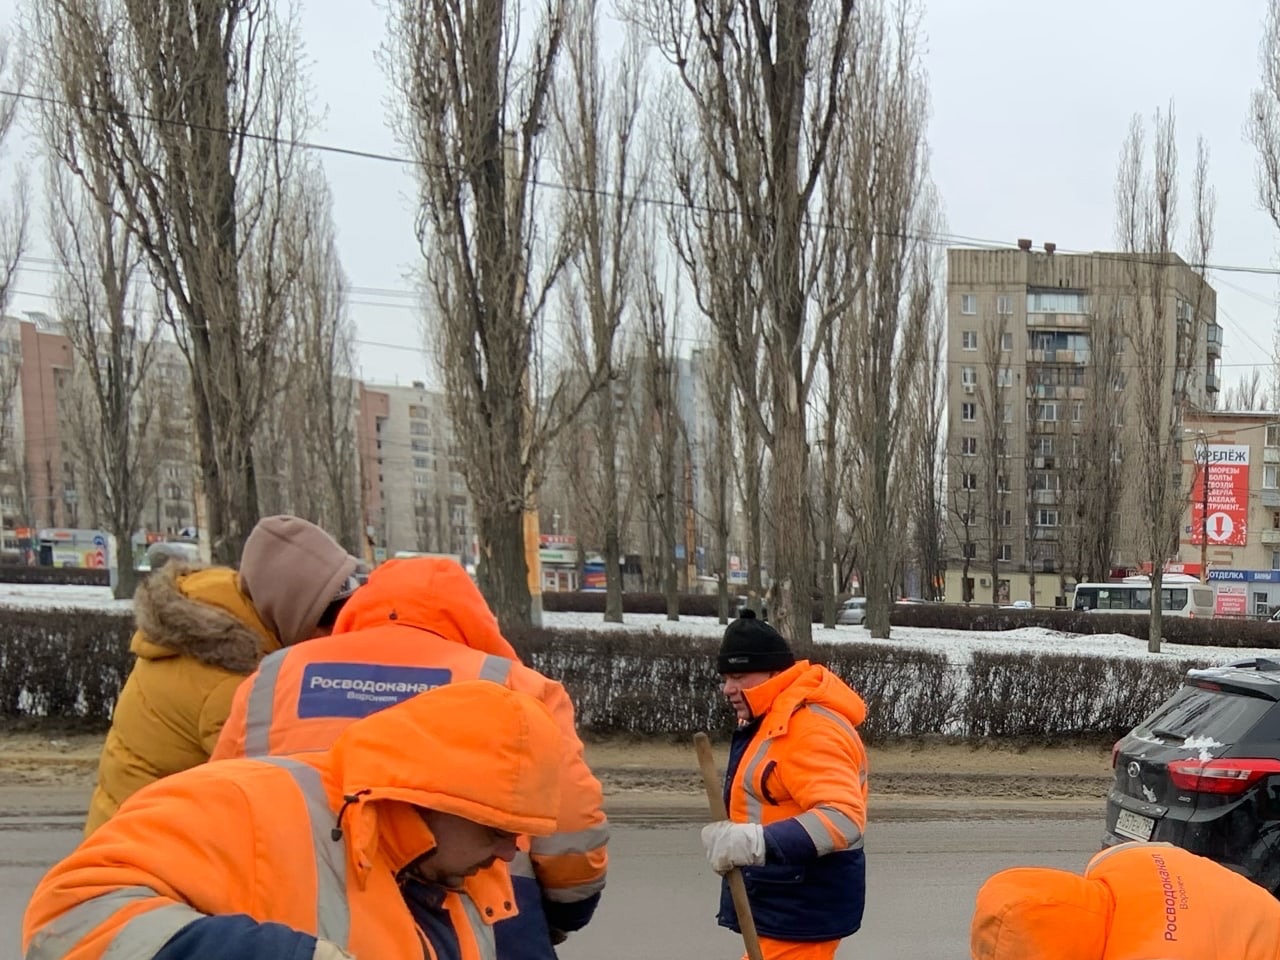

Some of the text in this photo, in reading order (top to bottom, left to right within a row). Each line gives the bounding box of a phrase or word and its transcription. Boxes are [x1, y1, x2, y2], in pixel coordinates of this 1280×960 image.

[1197, 449, 1246, 462] КРЕПЁЖ
[1209, 571, 1244, 580] ОТДЕЛКА
[1151, 853, 1178, 942] Росводоканал
